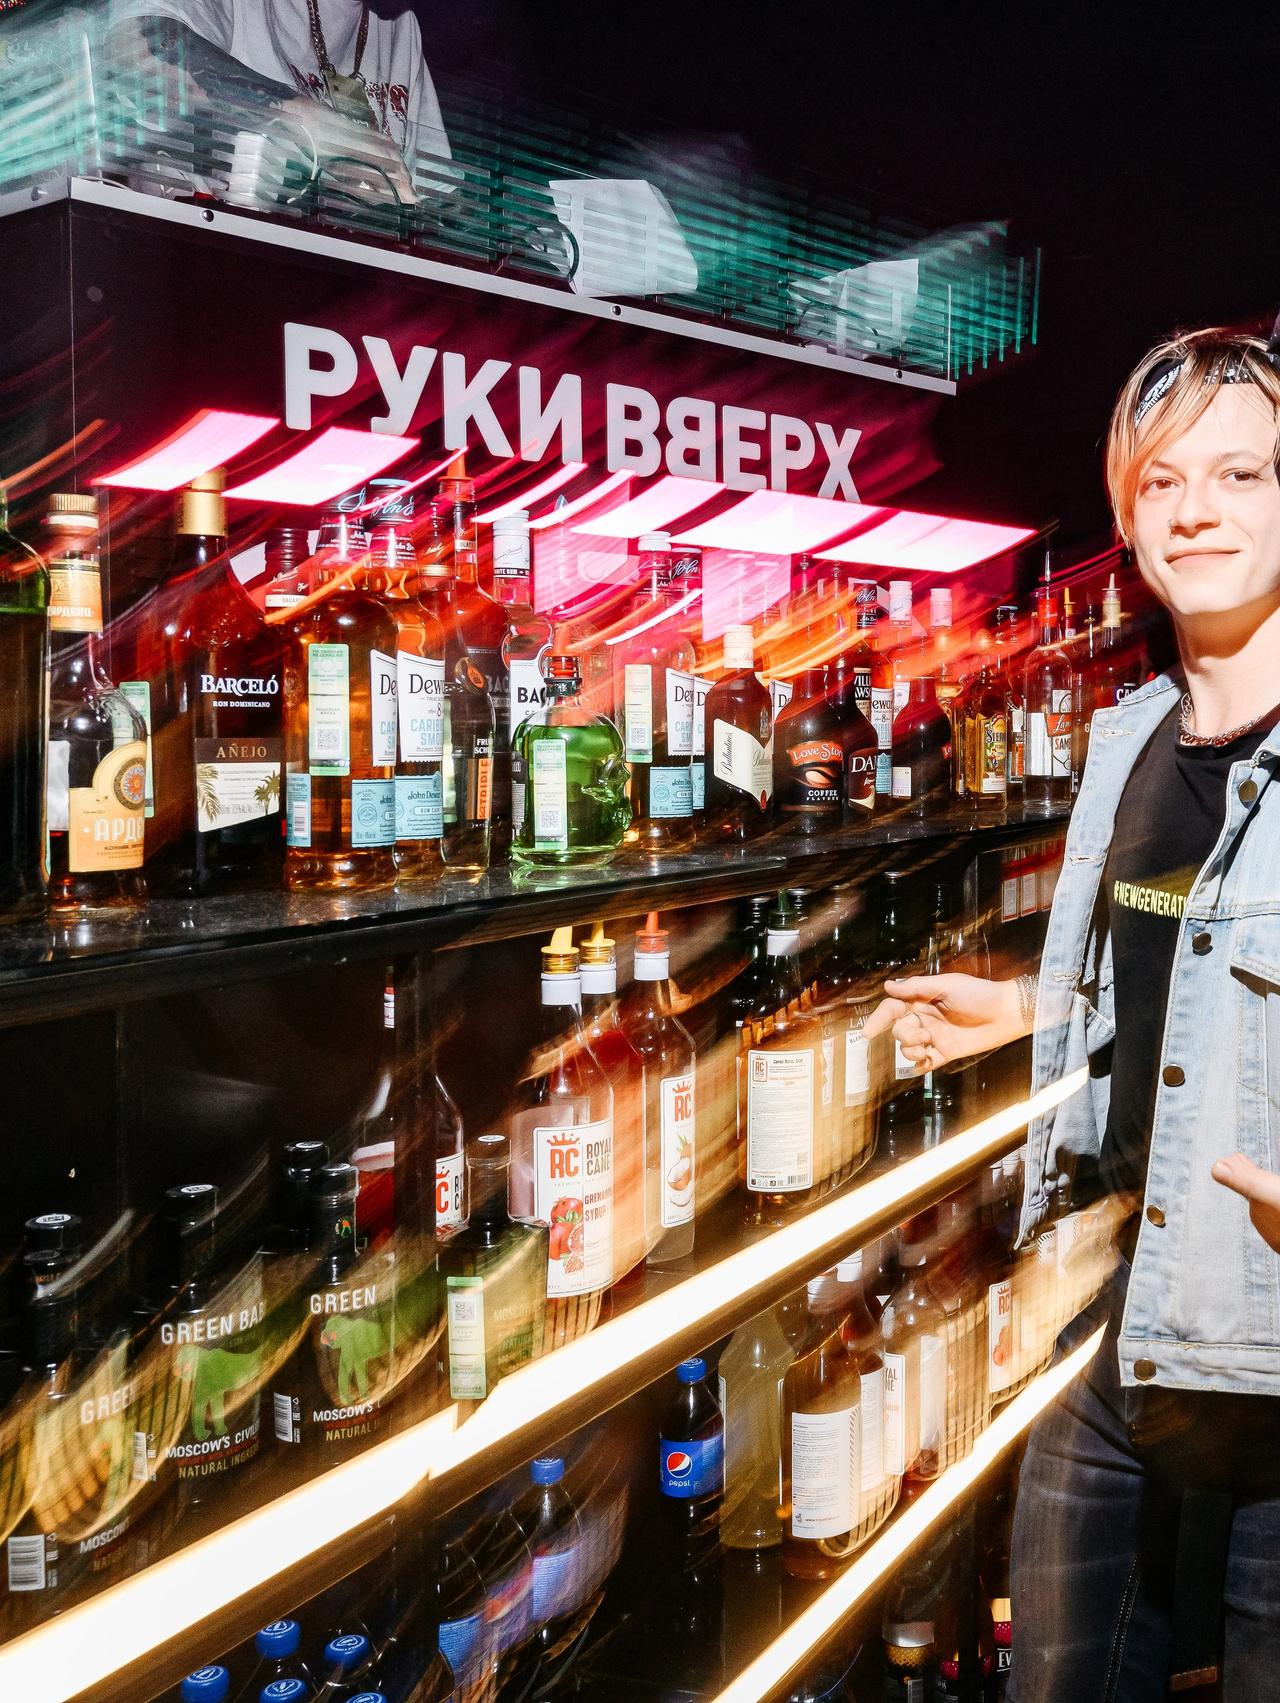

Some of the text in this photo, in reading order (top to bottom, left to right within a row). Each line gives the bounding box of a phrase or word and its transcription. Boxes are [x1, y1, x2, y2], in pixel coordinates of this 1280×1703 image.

[284, 322, 583, 463] РУКИ
[201, 674, 279, 697] BARCELÓ
[212, 700, 271, 708] RON DOMINICANO
[216, 742, 268, 759] AÑEJO
[807, 789, 838, 797] COFFEE
[674, 1093, 692, 1123] RC
[586, 1137, 612, 1160] ROYAL
[550, 1147, 580, 1179] RC
[586, 1154, 611, 1177] CANE
[584, 1205, 607, 1222] SYRUP
[310, 1285, 377, 1315] GREEN
[161, 1314, 234, 1345] GREEN
[313, 1400, 374, 1422] MOSCOW'S
[325, 1423, 372, 1442] NATURAL
[165, 1435, 231, 1460] MOSCOW'S
[178, 1461, 229, 1479] NATURAL
[668, 1479, 691, 1487] pepsi
